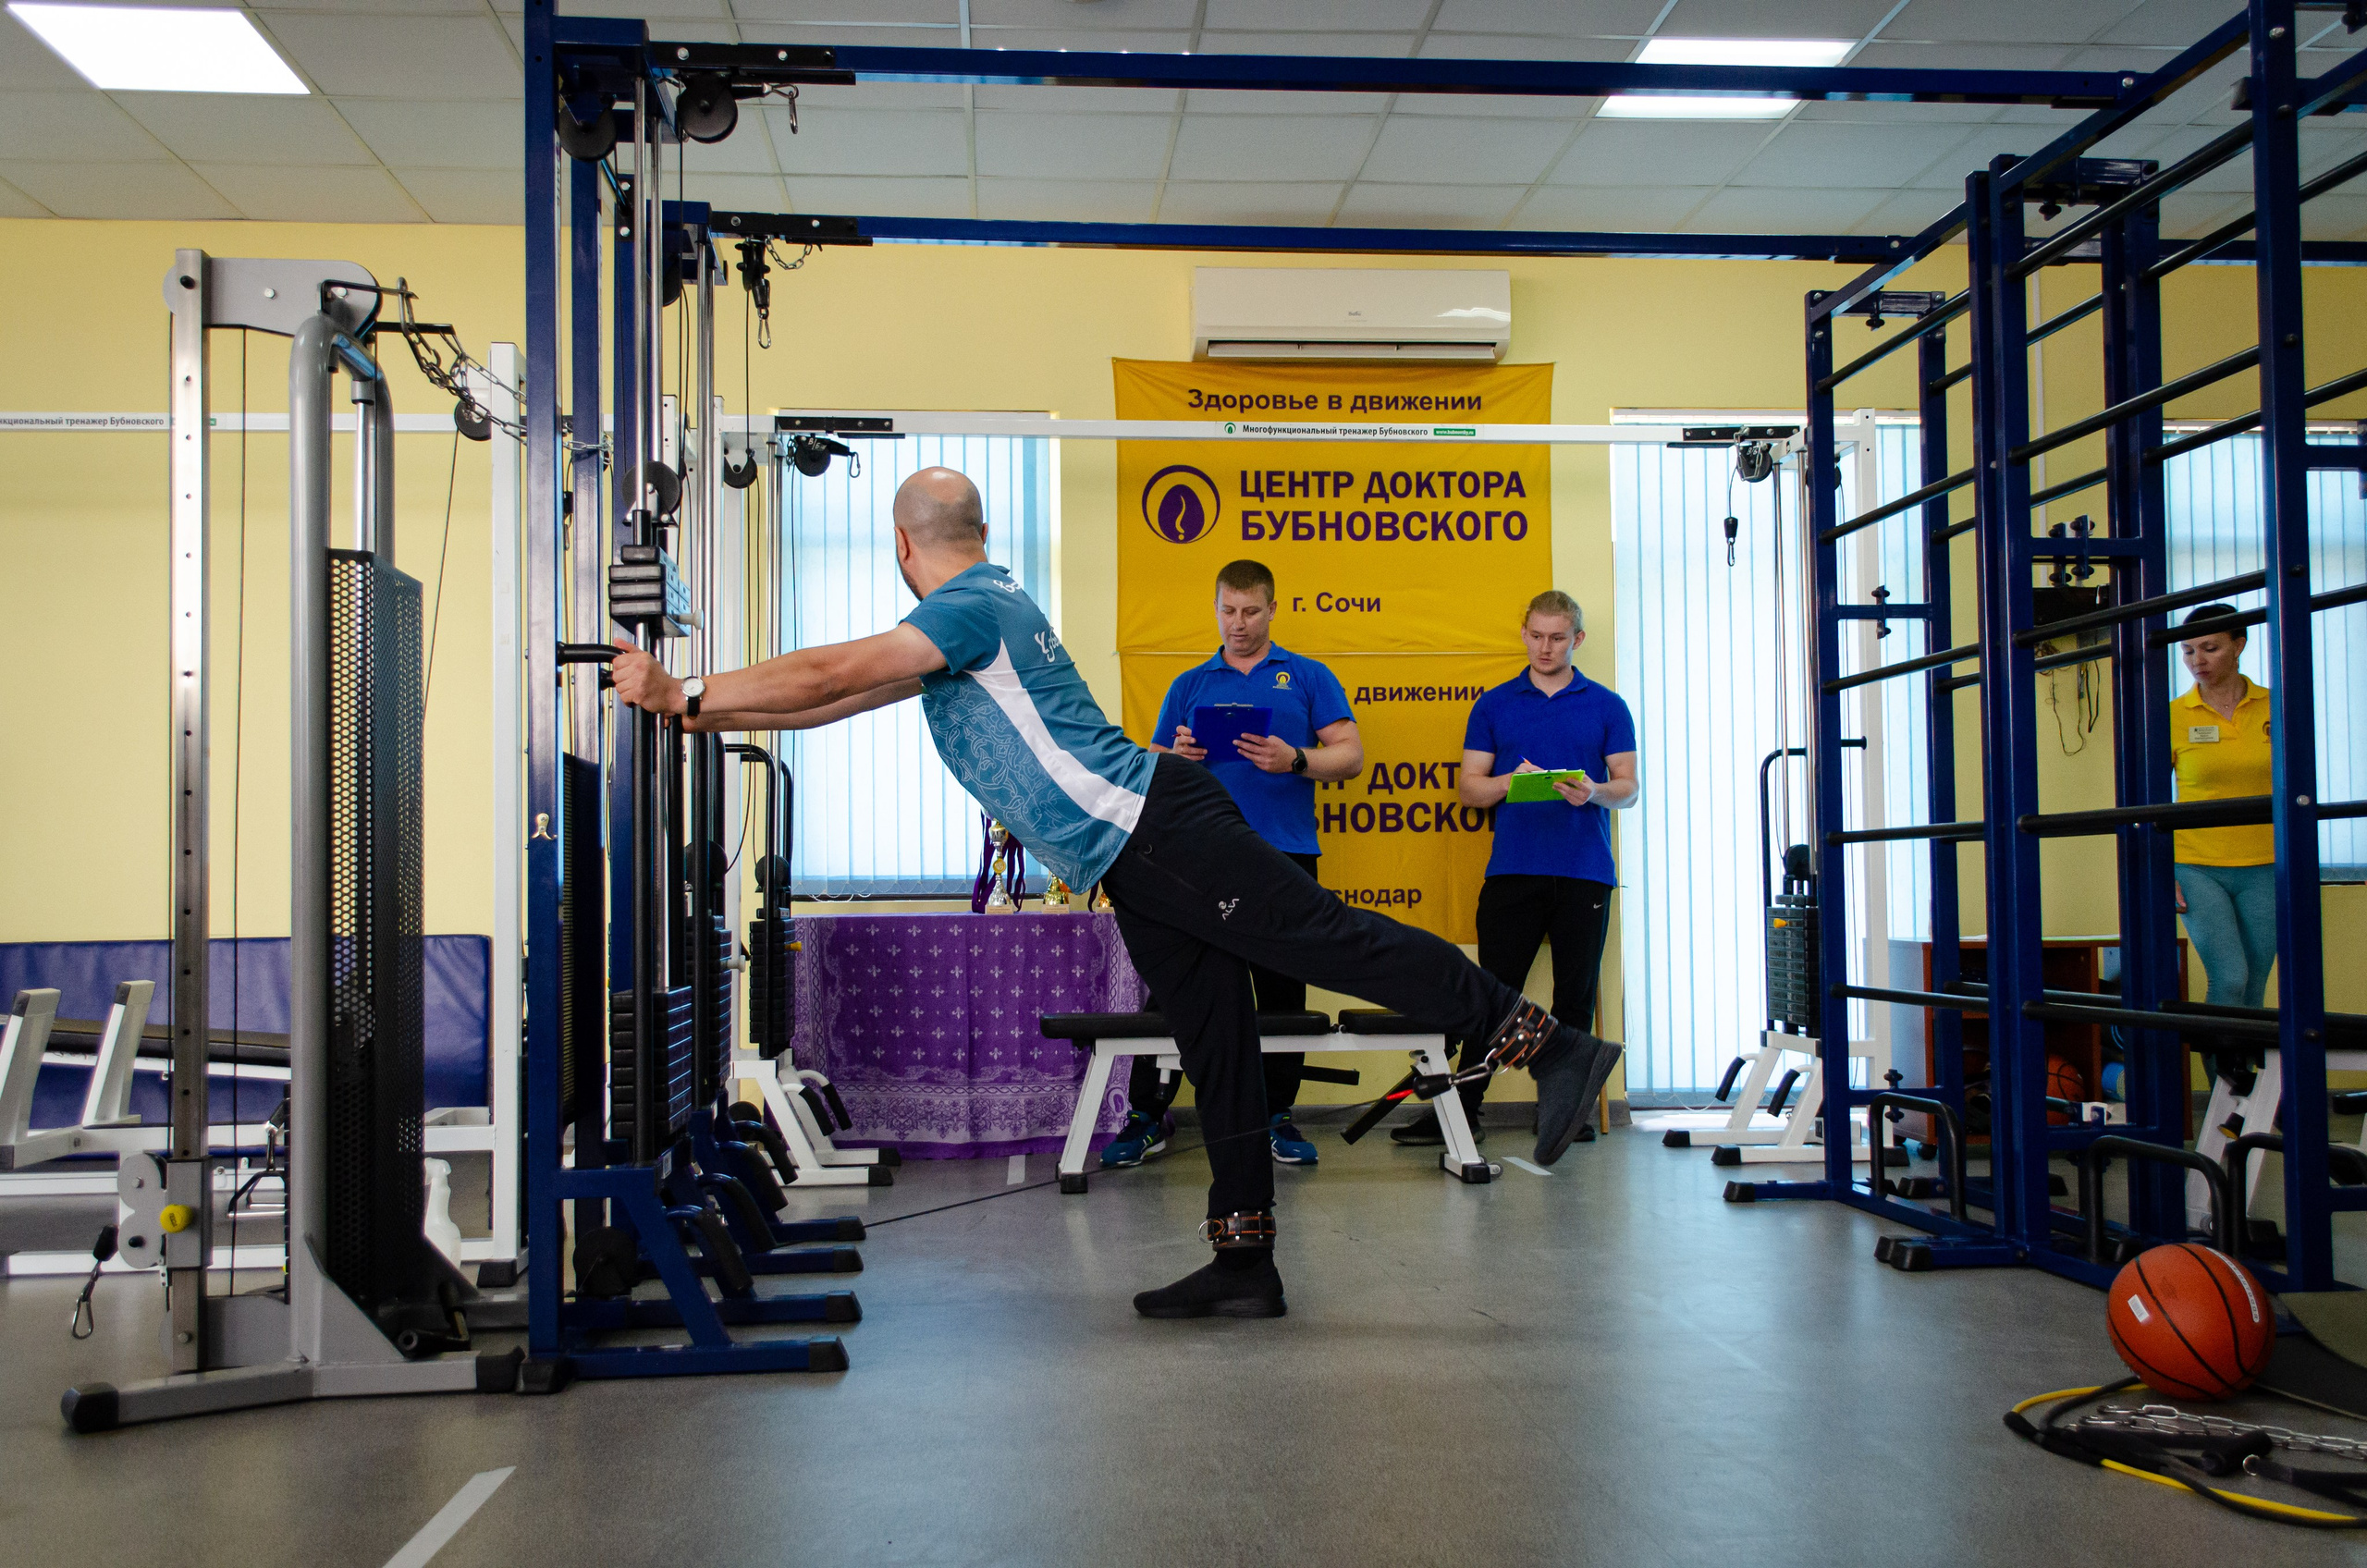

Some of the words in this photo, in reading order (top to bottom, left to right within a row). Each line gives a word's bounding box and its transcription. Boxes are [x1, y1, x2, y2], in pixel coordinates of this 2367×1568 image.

[1187, 388, 1318, 413] Здоровье
[1328, 395, 1343, 410] в
[1349, 395, 1481, 414] движении
[66, 419, 108, 427] тренажер
[110, 416, 165, 427] Бубновского
[1242, 424, 1337, 435] Многофункциональный
[1339, 427, 1378, 436] тренажер
[1379, 426, 1429, 437] Бубновского
[1240, 470, 1355, 502] ЦЕНТР
[1363, 471, 1527, 504] ДОКТОРА
[1241, 509, 1528, 542] БУБНОВСКОГО
[1293, 596, 1306, 612] г.
[1316, 591, 1381, 613] Сочи
[1354, 685, 1485, 705] движении
